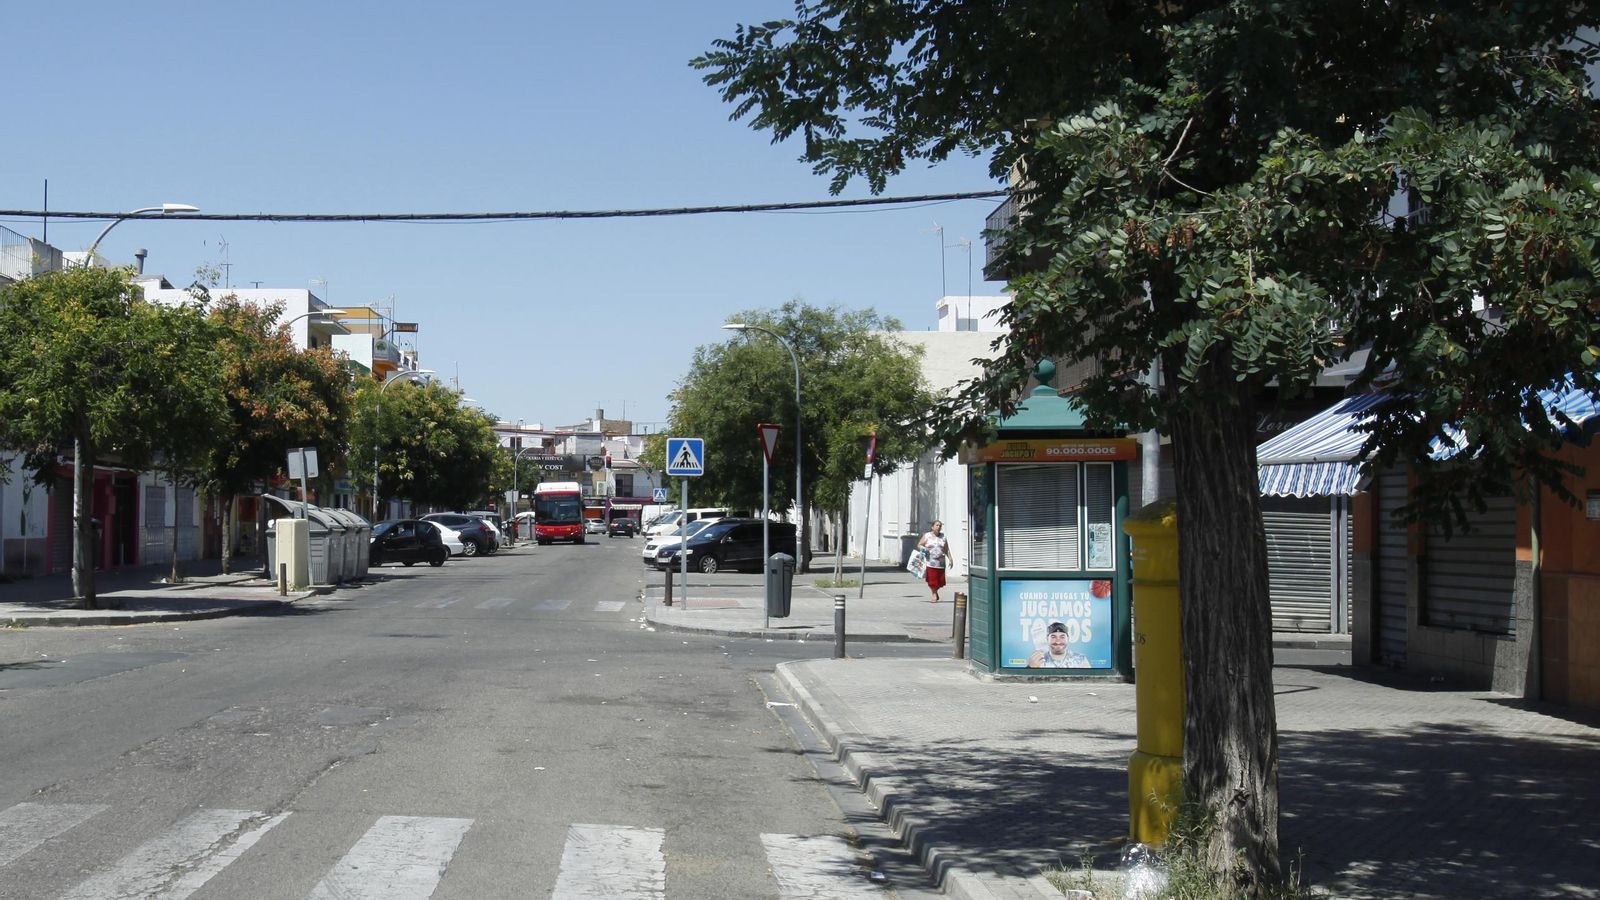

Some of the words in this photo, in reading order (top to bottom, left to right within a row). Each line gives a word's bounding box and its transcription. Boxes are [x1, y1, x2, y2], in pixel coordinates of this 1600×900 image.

[1046, 447, 1117, 455] 90.000.000€
[1019, 592, 1048, 600] CUANDO
[1051, 592, 1077, 600] JUEGAS
[1020, 600, 1092, 618] JUGAMOS
